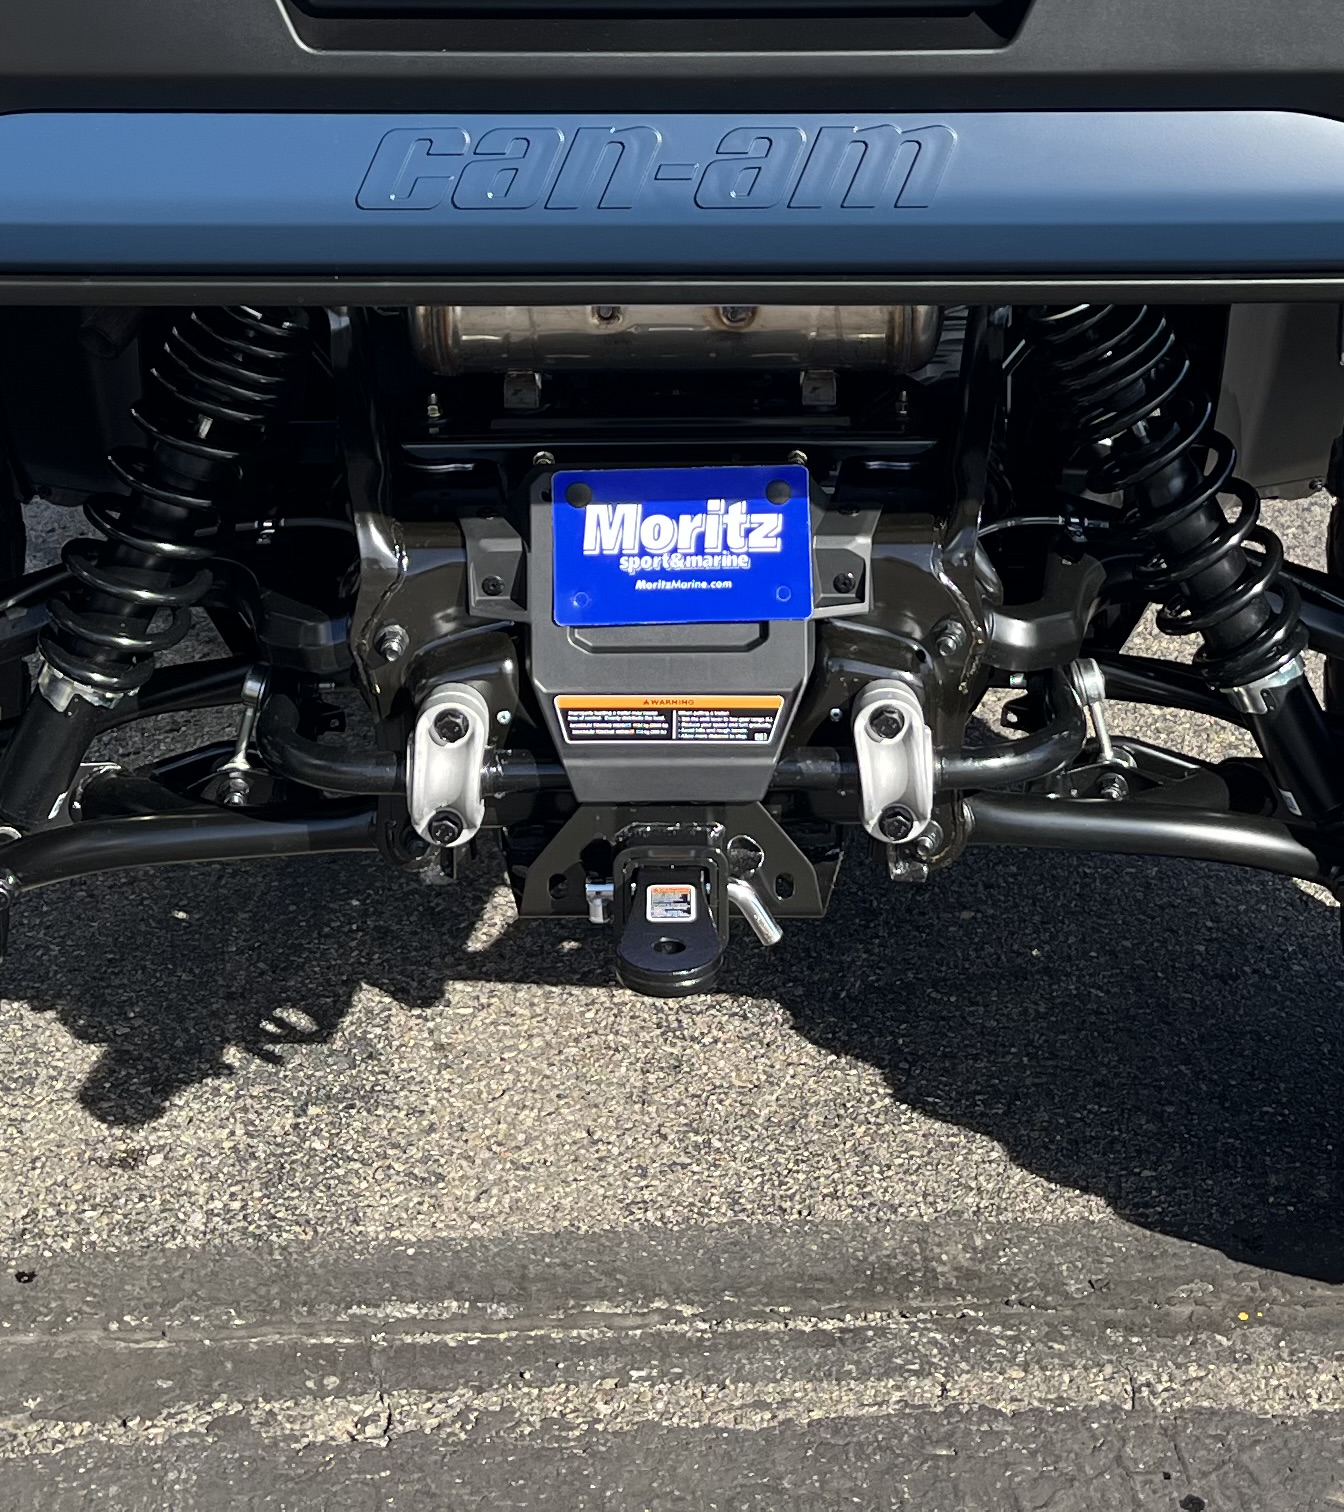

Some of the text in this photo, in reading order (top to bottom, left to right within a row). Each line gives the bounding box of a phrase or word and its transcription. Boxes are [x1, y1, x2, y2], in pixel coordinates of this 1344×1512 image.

[355, 123, 958, 210] can-am
[584, 499, 782, 554] Moritz
[620, 551, 750, 573] sport&marine
[635, 579, 733, 590] MoritzMarine.com
